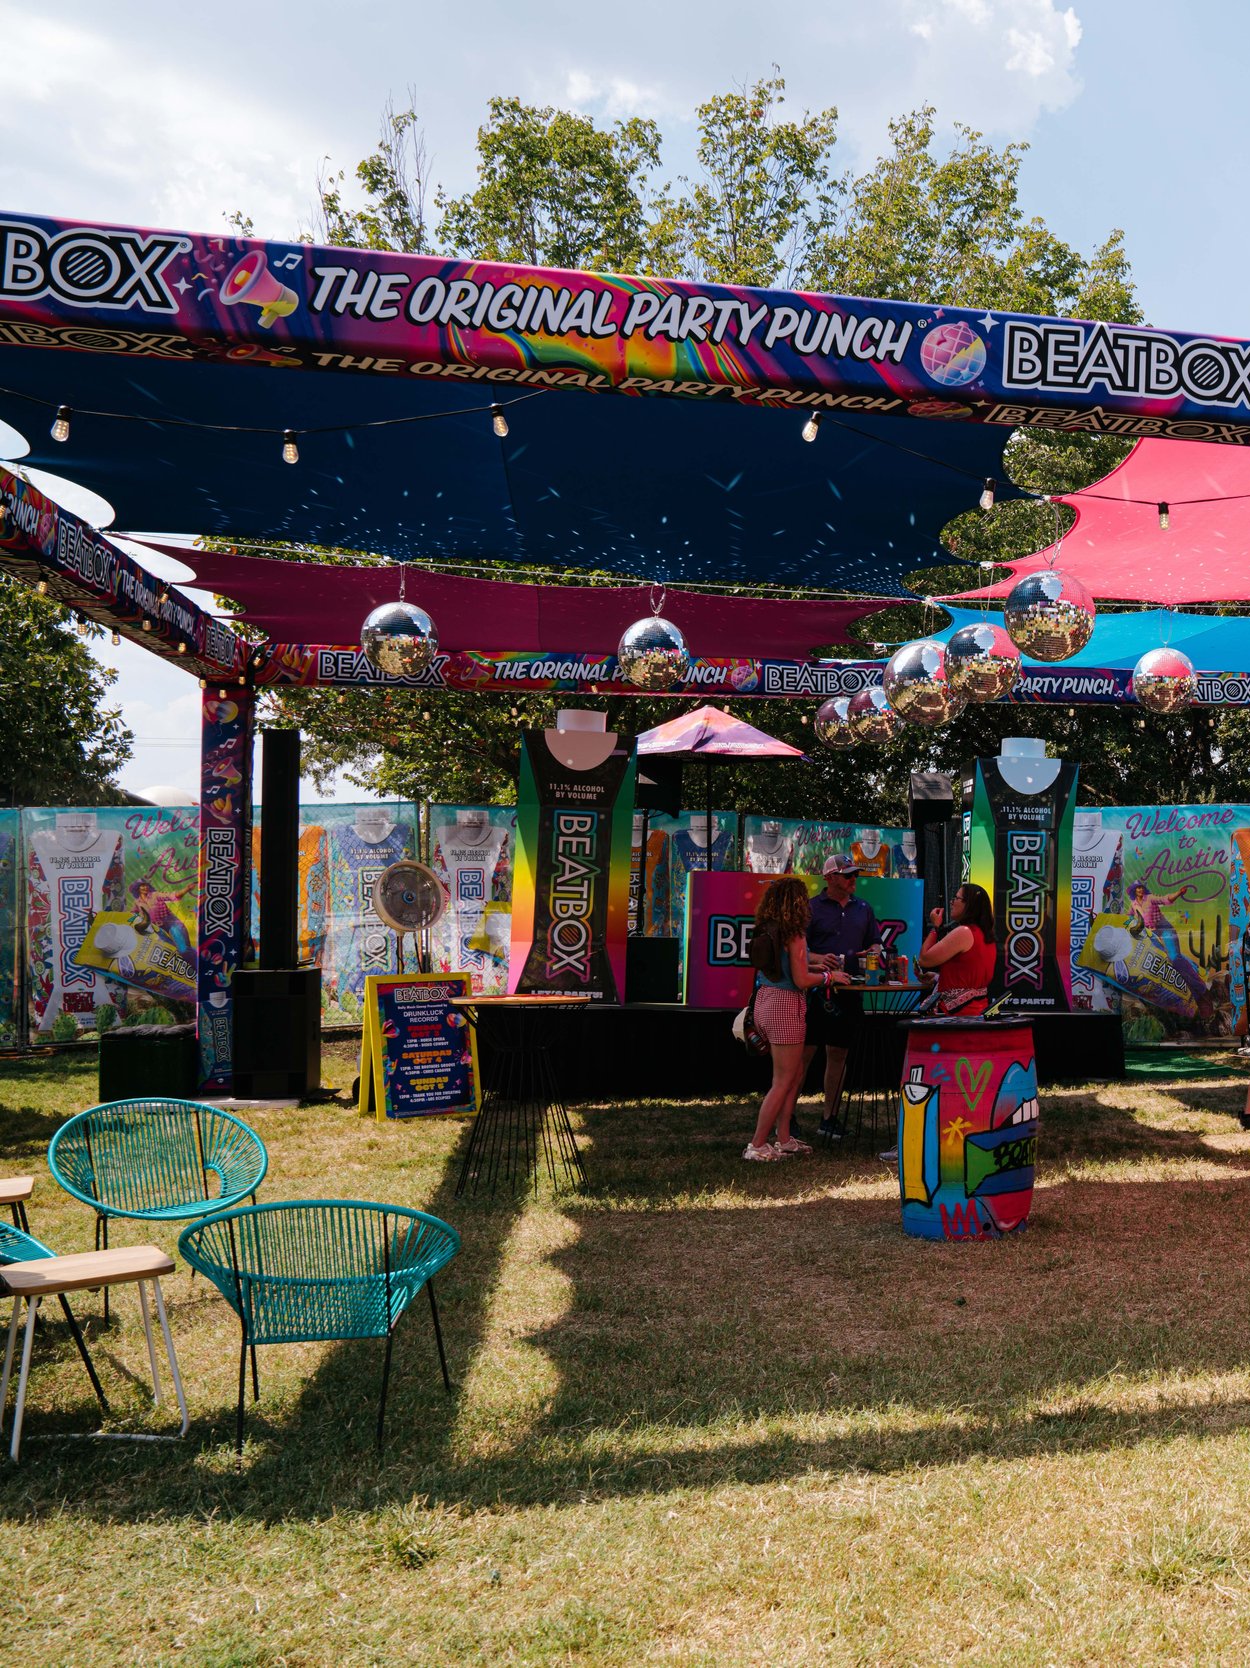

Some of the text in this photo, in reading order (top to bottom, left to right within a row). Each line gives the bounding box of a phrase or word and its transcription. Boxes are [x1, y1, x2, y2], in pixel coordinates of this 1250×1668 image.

[311, 266, 411, 321] THE
[405, 274, 618, 338] ORIGINAL
[622, 291, 769, 349] PARTY
[311, 352, 904, 412] THE ORIGINAL PARTY PUNCH
[58, 518, 112, 593] BEATBOX
[493, 661, 531, 680] THE
[529, 661, 609, 682] ORIGINAL
[766, 663, 880, 695] BEATBOX
[1011, 676, 1116, 696] PARTY PUNCH
[550, 782, 604, 793] 11.1% ALCOHOL
[567, 792, 597, 801] VOLUME
[1023, 807, 1051, 815] ALCOHOL
[1126, 808, 1236, 840] Welcome
[1178, 835, 1199, 849] to
[1140, 849, 1229, 882] Austin
[206, 828, 236, 936] BEATBOX
[553, 815, 593, 972] BEATBOX
[1010, 834, 1041, 980] BEATBOX
[395, 987, 449, 1002] BEATBOX
